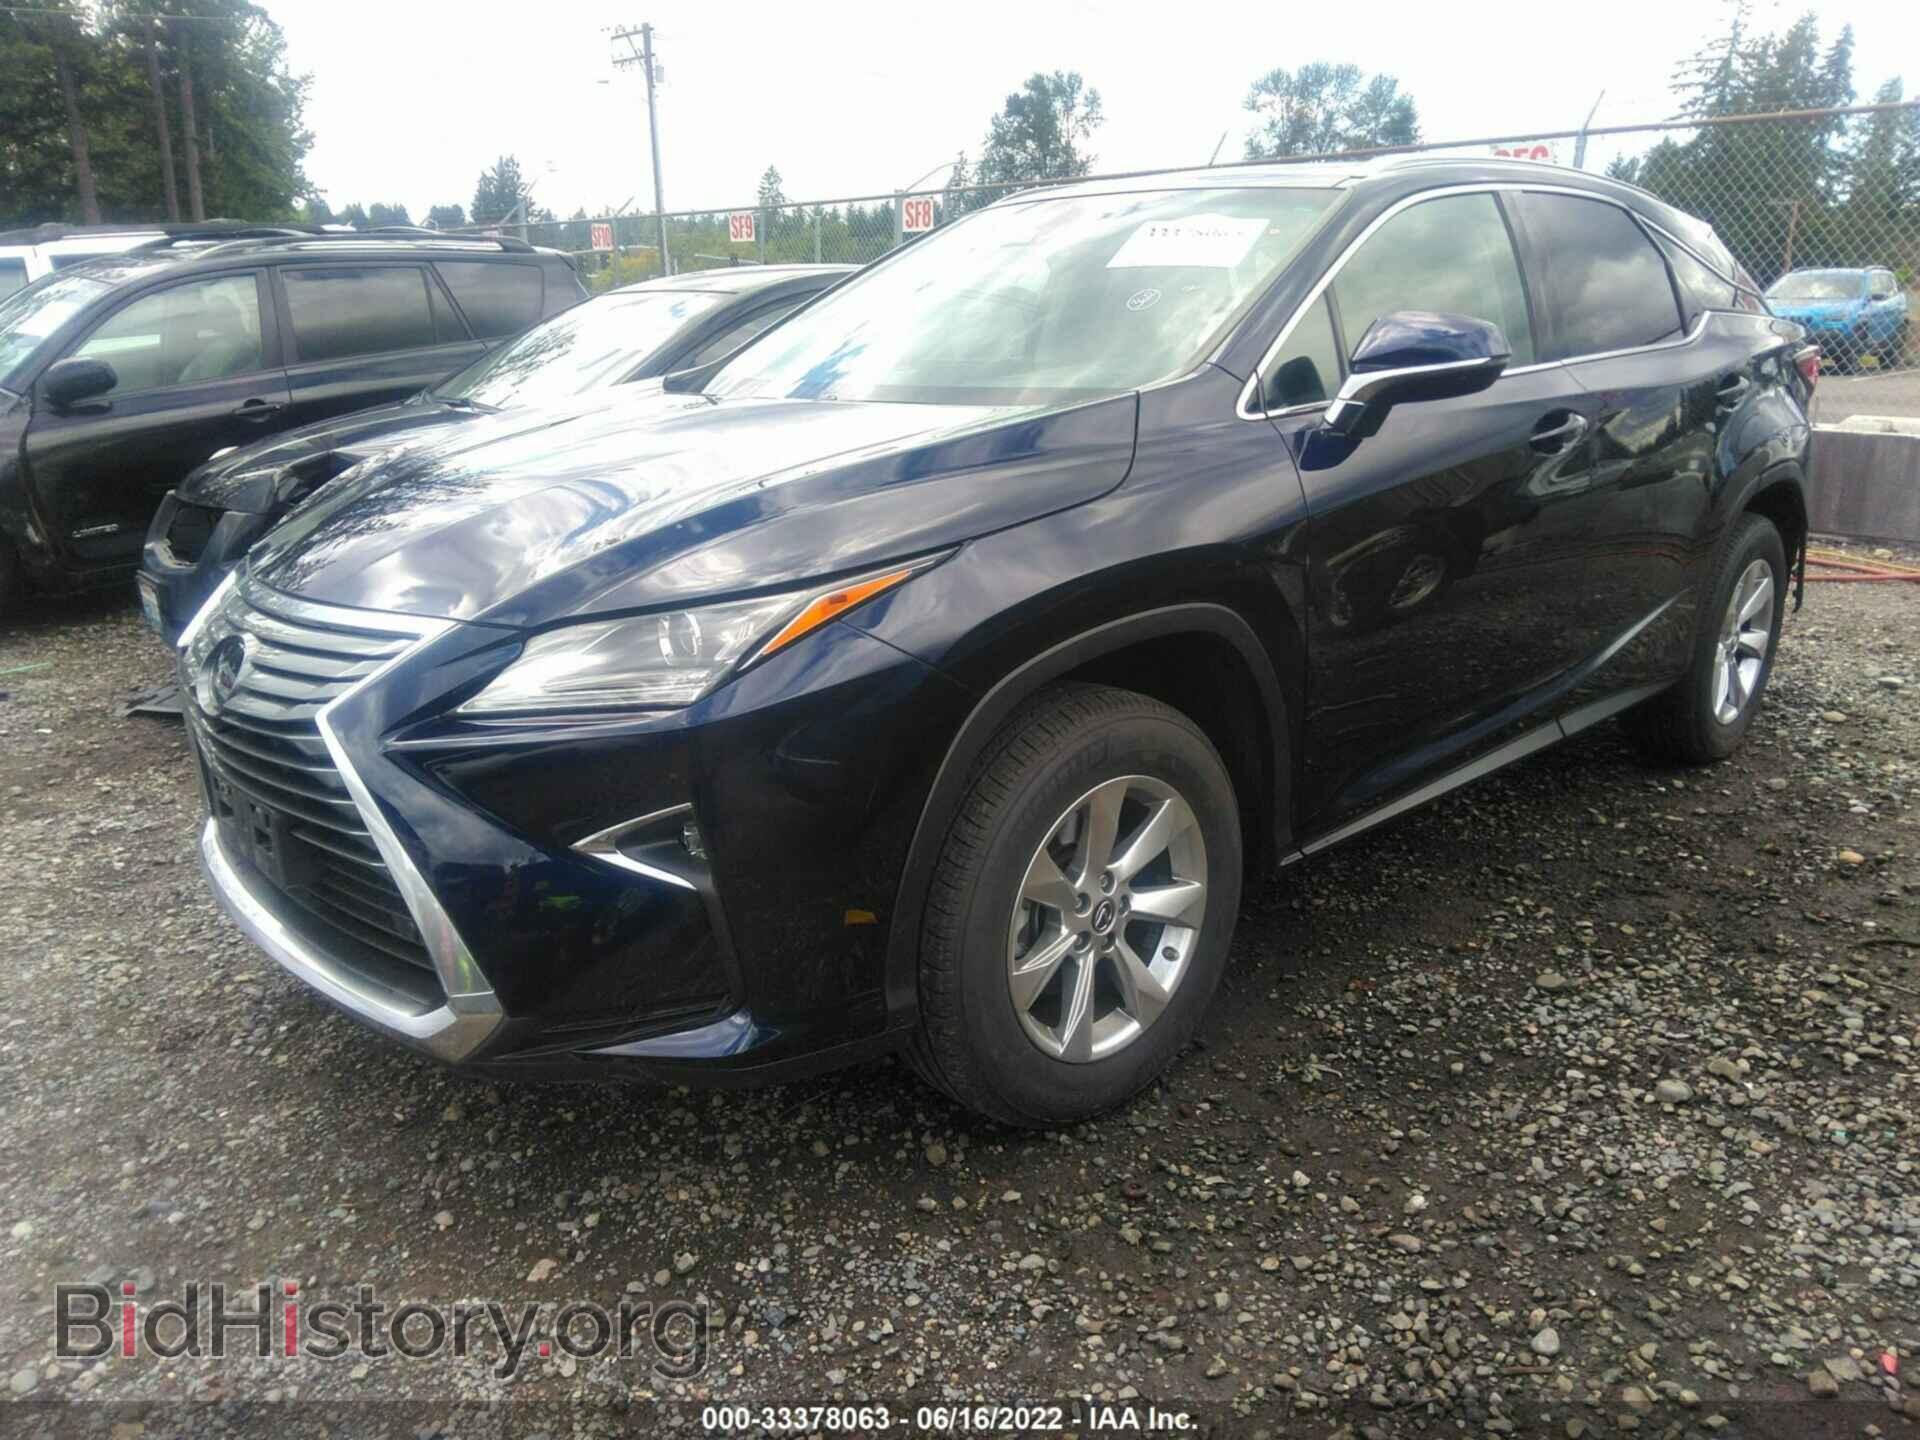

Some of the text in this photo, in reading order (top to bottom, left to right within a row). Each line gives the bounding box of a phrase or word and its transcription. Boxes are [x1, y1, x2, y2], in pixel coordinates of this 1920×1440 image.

[905, 200, 931, 228] SF8
[592, 226, 610, 247] SF10
[731, 215, 752, 239] SF9
